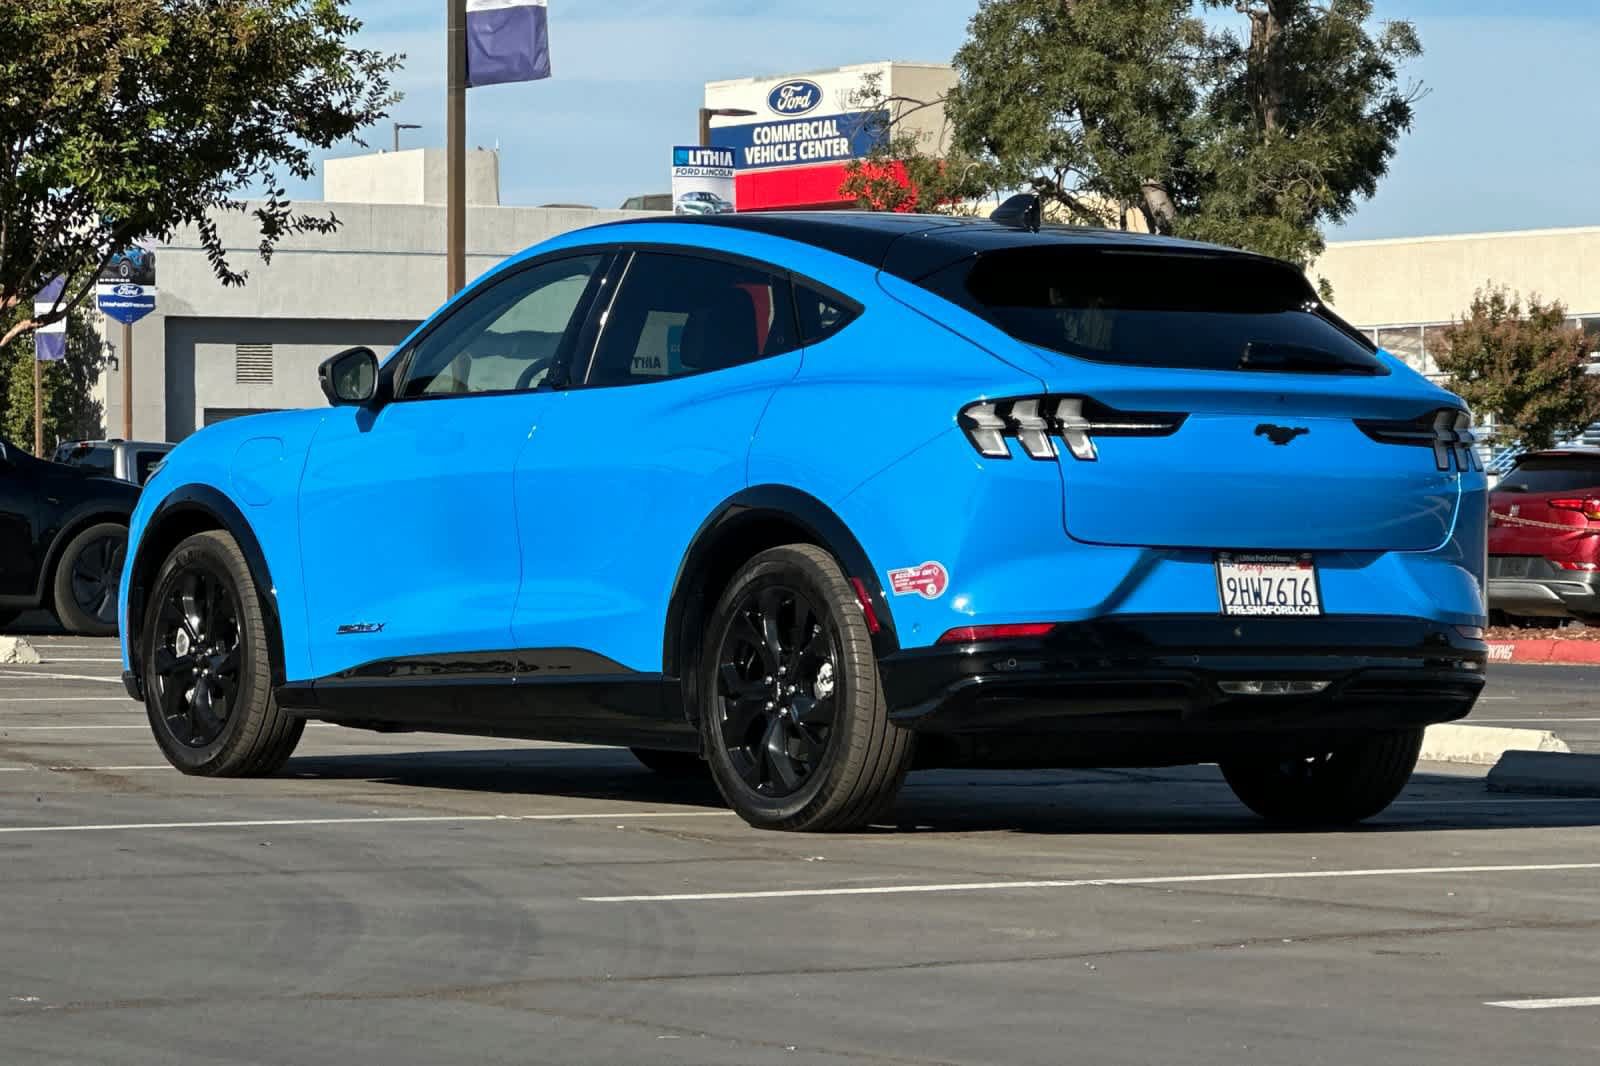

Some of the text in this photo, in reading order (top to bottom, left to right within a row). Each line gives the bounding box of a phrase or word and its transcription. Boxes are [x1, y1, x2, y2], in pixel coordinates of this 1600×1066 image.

[777, 85, 813, 111] Ford
[752, 119, 840, 145] COMMERCIAL
[688, 149, 734, 167] LITHIA
[744, 137, 850, 165] VEHICLE CENTER
[675, 167, 734, 177] FORD LINCOLN
[633, 356, 662, 369] THIA
[1226, 577, 1312, 607] 9HWZ676
[1227, 605, 1320, 616] FRESNOFORD.COM
